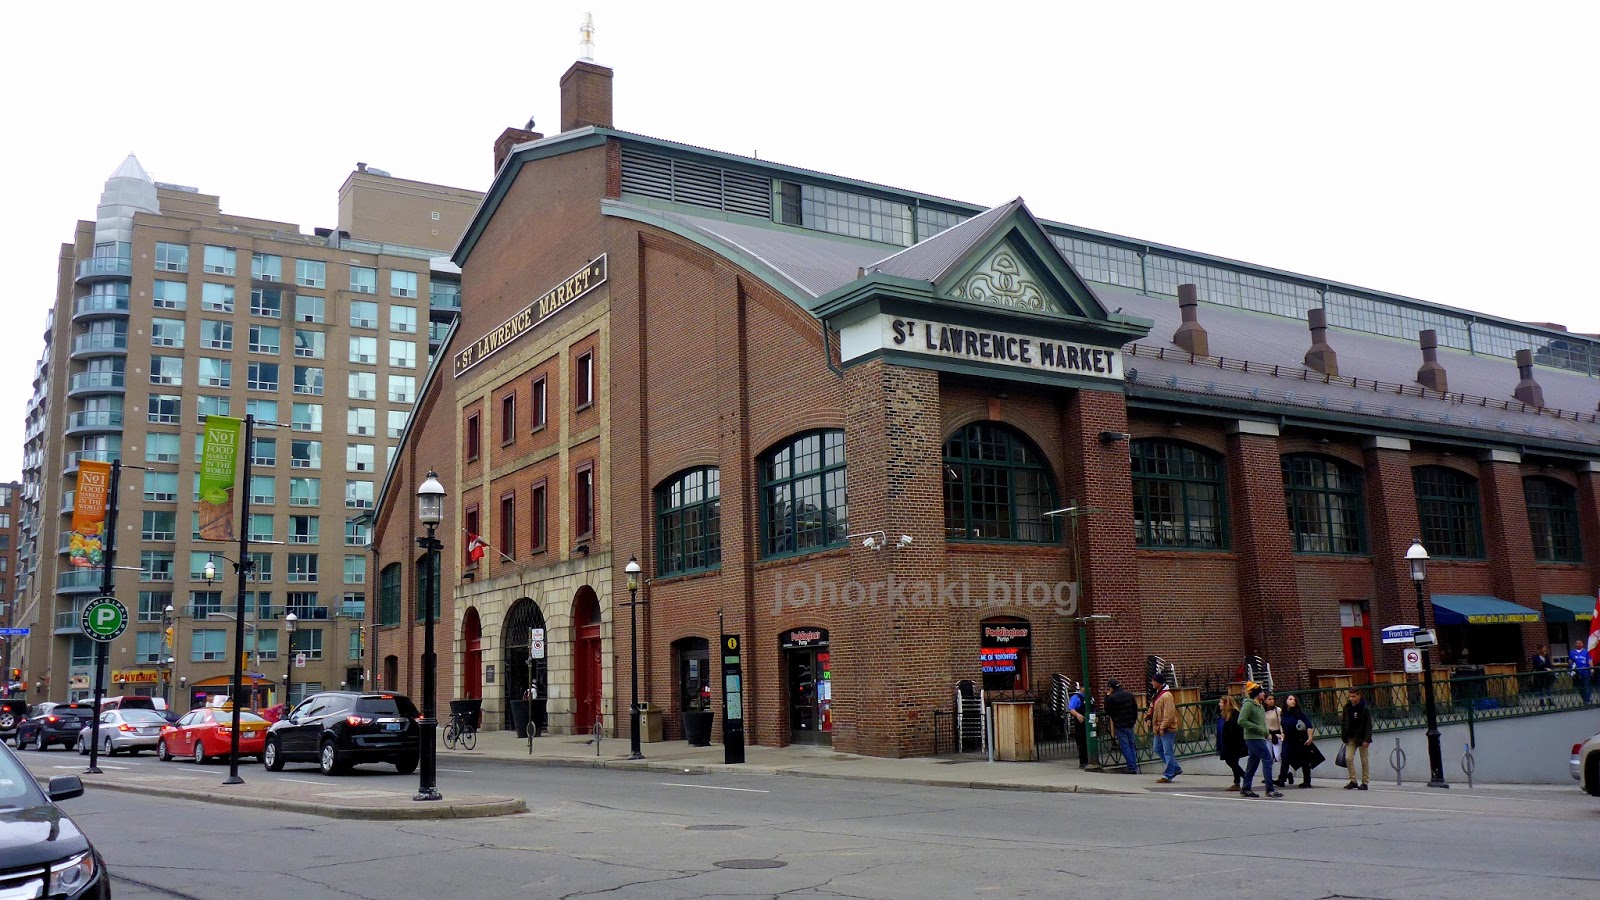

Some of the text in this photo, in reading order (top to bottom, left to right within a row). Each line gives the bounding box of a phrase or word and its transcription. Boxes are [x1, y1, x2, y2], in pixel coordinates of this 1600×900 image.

[462, 267, 591, 368] ST LAWRENCE MARKET
[925, 323, 1032, 363] LAWRENCE
[1039, 342, 1115, 374] MARKET
[206, 444, 234, 455] FOOD
[206, 453, 233, 461] MARKET
[216, 461, 232, 469] THE
[205, 467, 232, 475] WORLD
[80, 485, 104, 494] FOOD
[84, 598, 127, 618] MUNICIPAL
[97, 608, 116, 626] P
[83, 621, 126, 640] PARKING
[1388, 630, 1404, 638] Front
